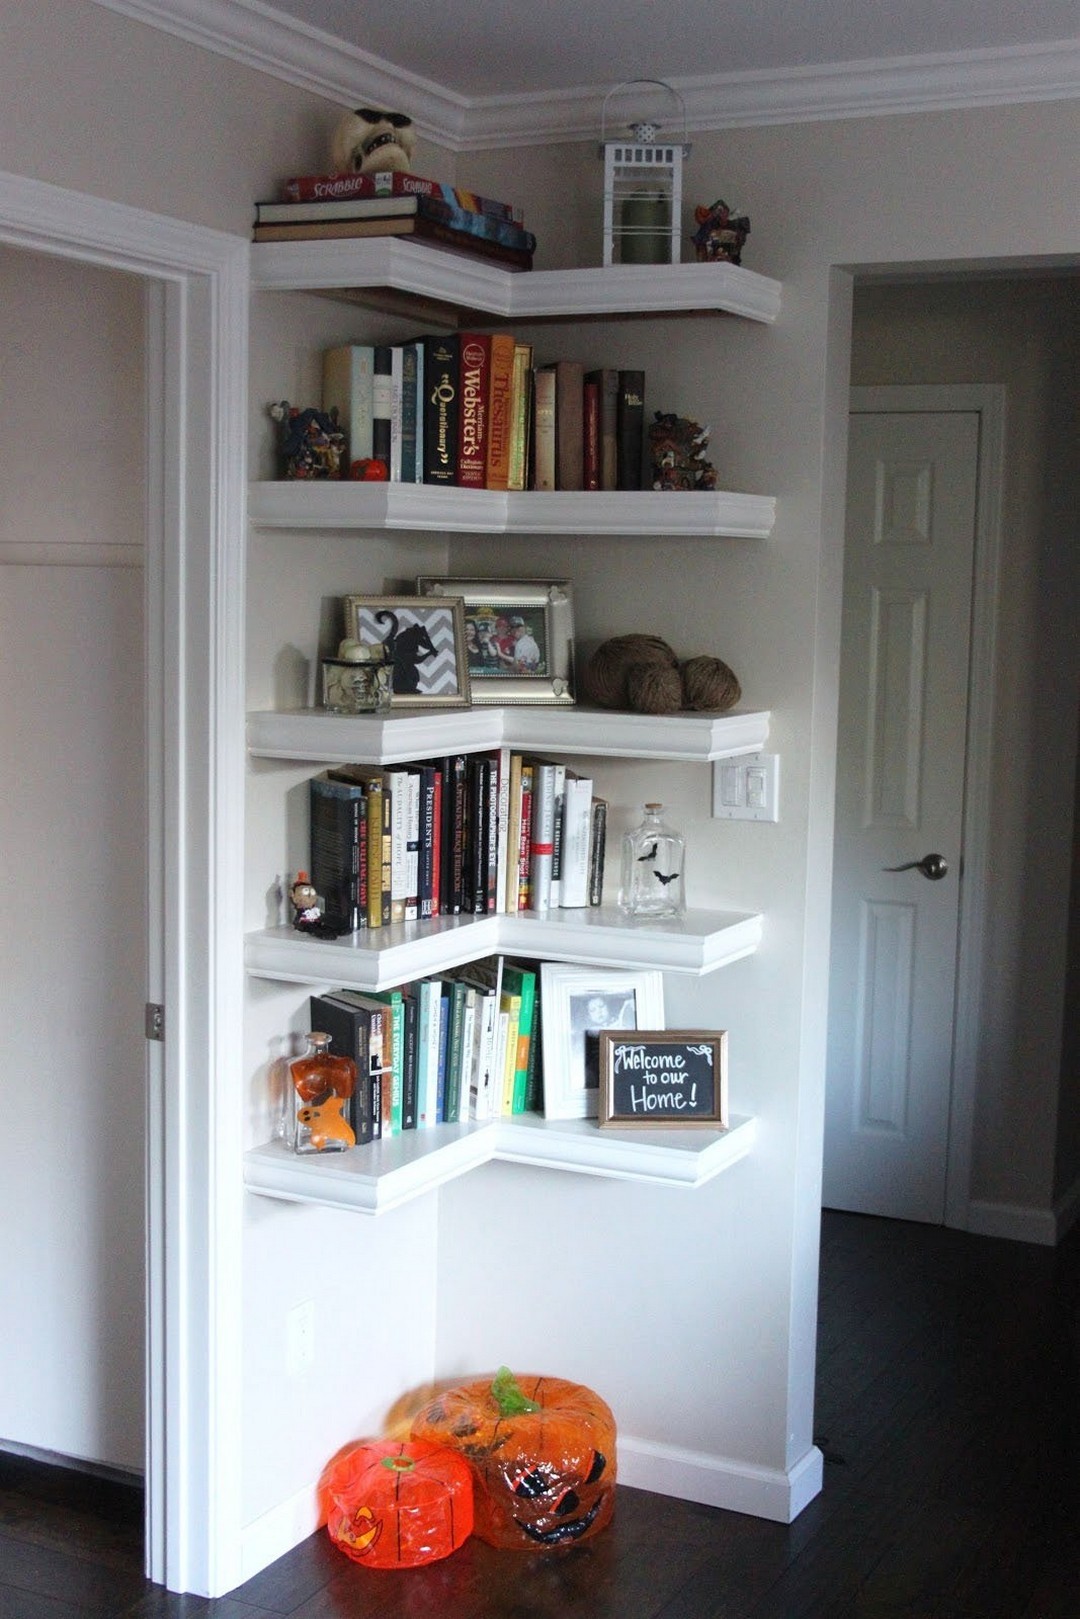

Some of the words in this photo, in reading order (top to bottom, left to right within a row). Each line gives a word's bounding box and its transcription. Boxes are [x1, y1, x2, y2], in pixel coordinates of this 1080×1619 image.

[463, 368, 482, 457] Webster's
[491, 373, 511, 467] Thesaurus
[425, 786, 435, 848] PRESIDENTS
[499, 778, 510, 833] Decorating
[622, 1048, 686, 1070] Welcome
[643, 1070, 658, 1085] to
[661, 1072, 689, 1085] our
[392, 1075, 400, 1107] GENIUS
